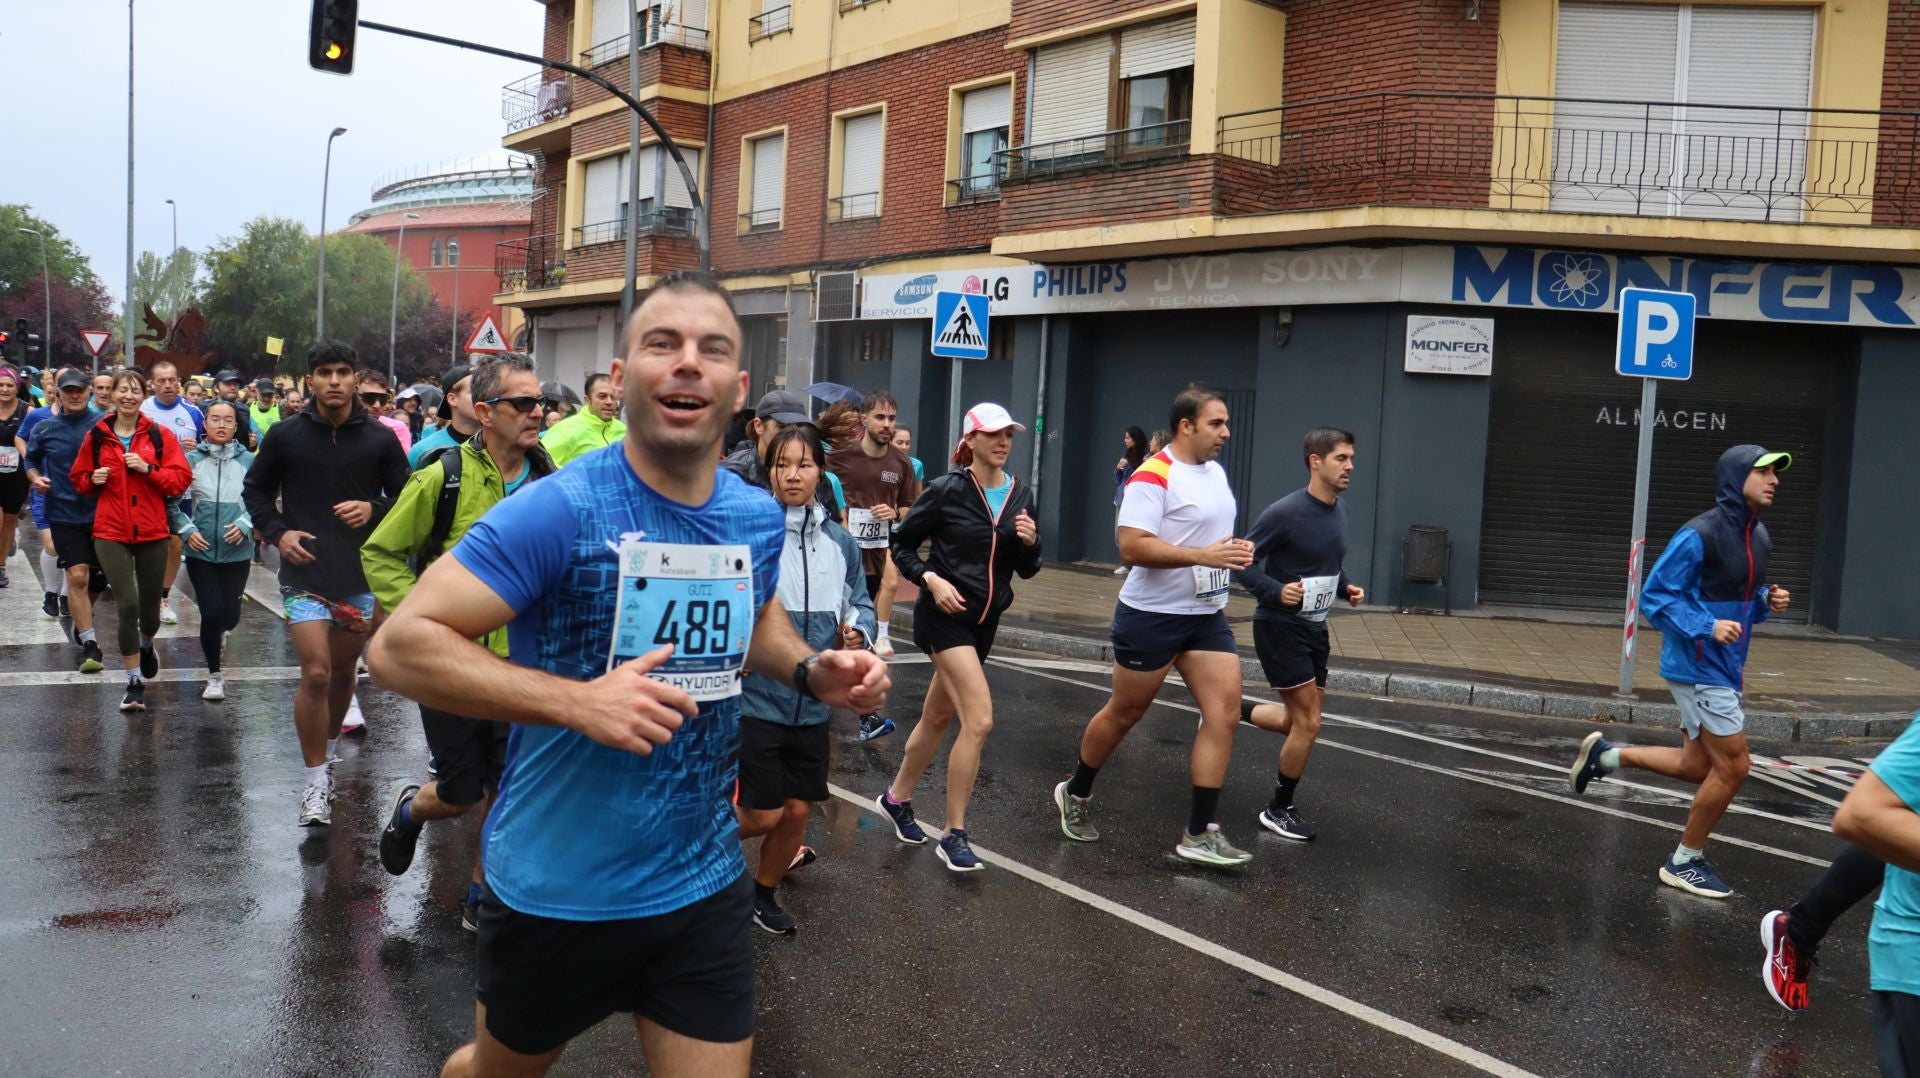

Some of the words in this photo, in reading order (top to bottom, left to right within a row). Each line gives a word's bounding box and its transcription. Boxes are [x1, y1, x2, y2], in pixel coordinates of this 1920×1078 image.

[1033, 263, 1128, 298] PHILIPS
[1153, 256, 1230, 292] JVC
[1262, 252, 1384, 284] SONY
[899, 282, 935, 297] SAMSUN
[982, 276, 1009, 302] LG
[1452, 246, 1915, 325] MONFER
[863, 306, 928, 318] SERVICIO
[1149, 292, 1241, 308] TECNICA
[1634, 300, 1680, 366] P
[1411, 340, 1490, 353] MONFER
[859, 523, 881, 536] 738
[1209, 567, 1228, 591] 1112
[1314, 591, 1333, 610] 817
[653, 600, 730, 655] 489
